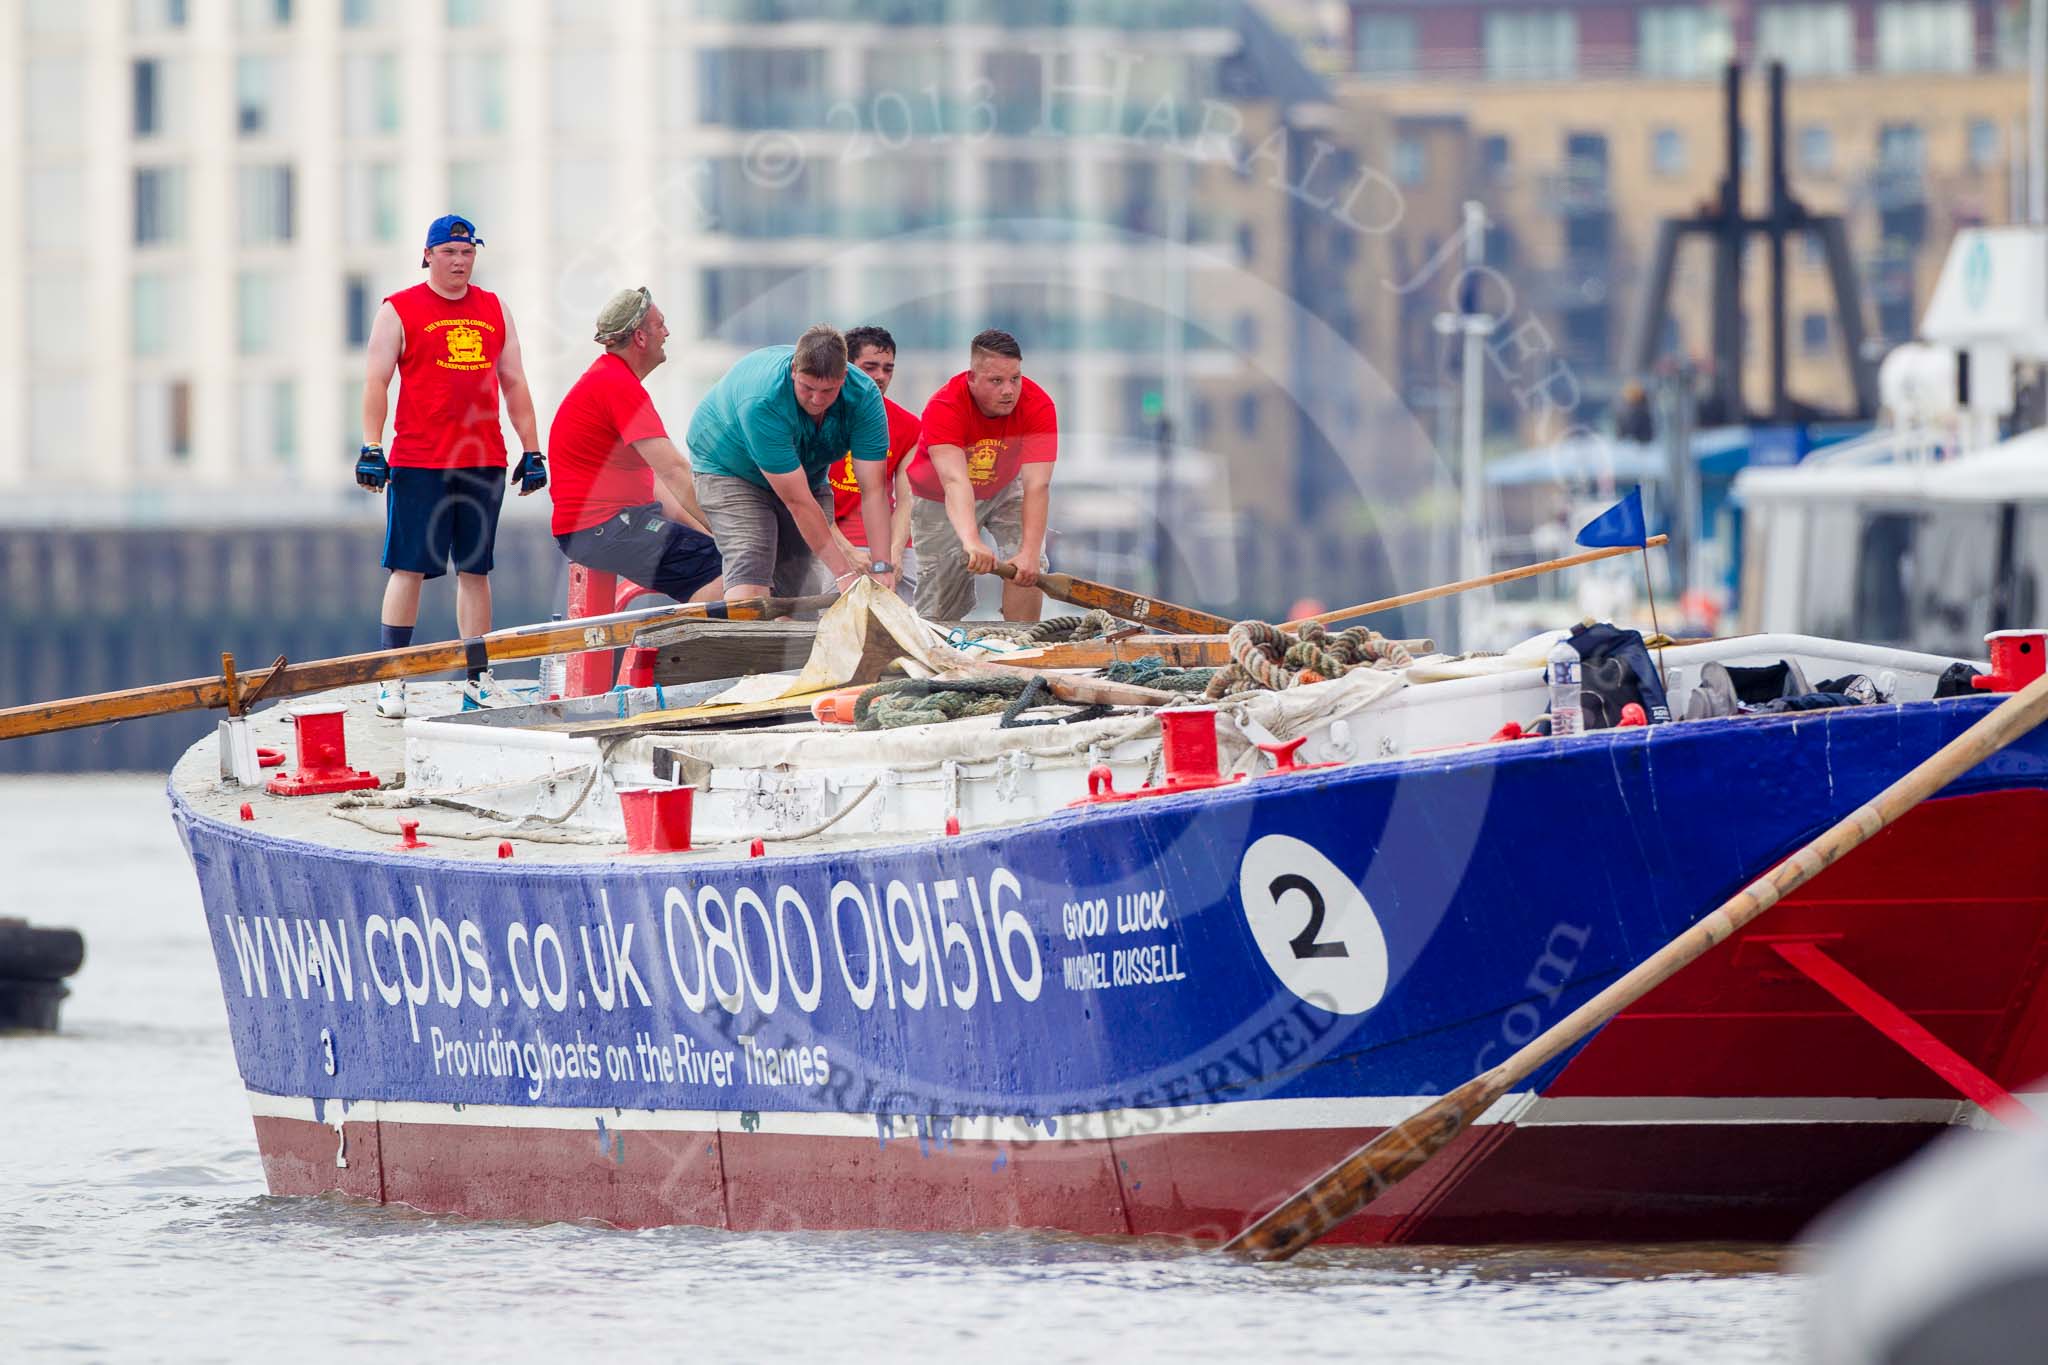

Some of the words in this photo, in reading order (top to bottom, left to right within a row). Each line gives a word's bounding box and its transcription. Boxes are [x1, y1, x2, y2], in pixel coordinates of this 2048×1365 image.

[436, 359, 469, 370] TRANSPORT
[830, 478, 862, 494] TRANSPOR
[1062, 897, 1109, 941] GOOD
[1117, 889, 1169, 931] LUCK
[1268, 873, 1349, 960] 2
[224, 885, 652, 1043] www.cpbs.co.uk
[664, 884, 824, 1014] 0800
[1063, 952, 1112, 992] MICHAEL
[1112, 944, 1186, 986] RUSSELL
[606, 1041, 635, 1082] on
[635, 1034, 676, 1083] the
[674, 1033, 736, 1088] River
[737, 1035, 830, 1087] Thames
